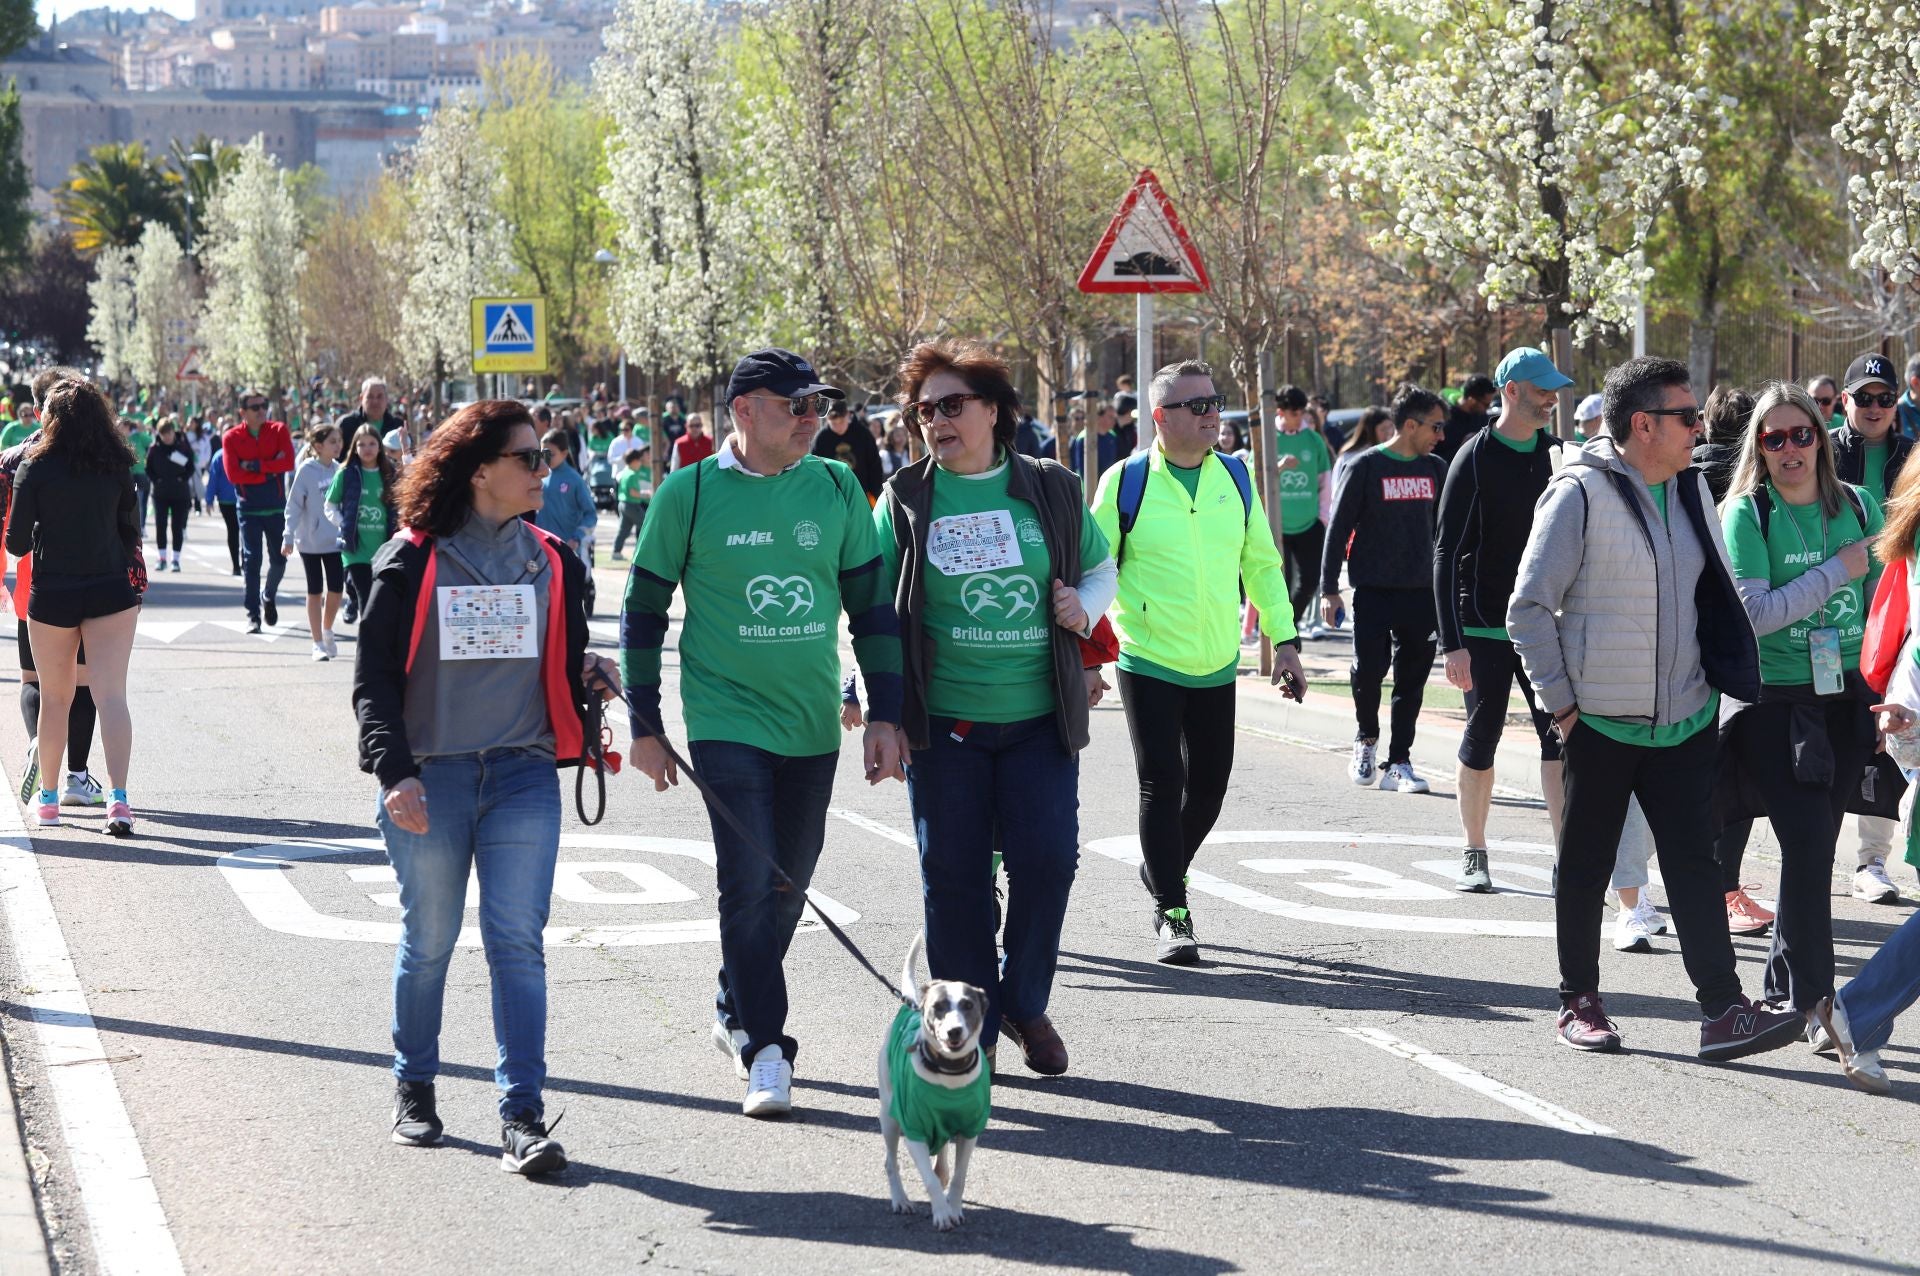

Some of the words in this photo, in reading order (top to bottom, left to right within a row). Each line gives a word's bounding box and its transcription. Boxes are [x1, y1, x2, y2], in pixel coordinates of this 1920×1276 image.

[1866, 360, 1880, 374] NY
[1383, 478, 1433, 500] MARVEL
[726, 531, 774, 546] INAEL
[937, 539, 961, 553] MARCHA
[994, 534, 1011, 543] ELLOS
[1784, 551, 1823, 564] INAEL
[739, 625, 776, 637] Brilla
[779, 626, 801, 636] con
[803, 621, 826, 634] ellos
[952, 626, 993, 641] Brilla
[996, 630, 1020, 641] con
[1022, 626, 1049, 640] ellos
[1790, 627, 1809, 638] Bri
[1732, 1013, 1758, 1035] N
